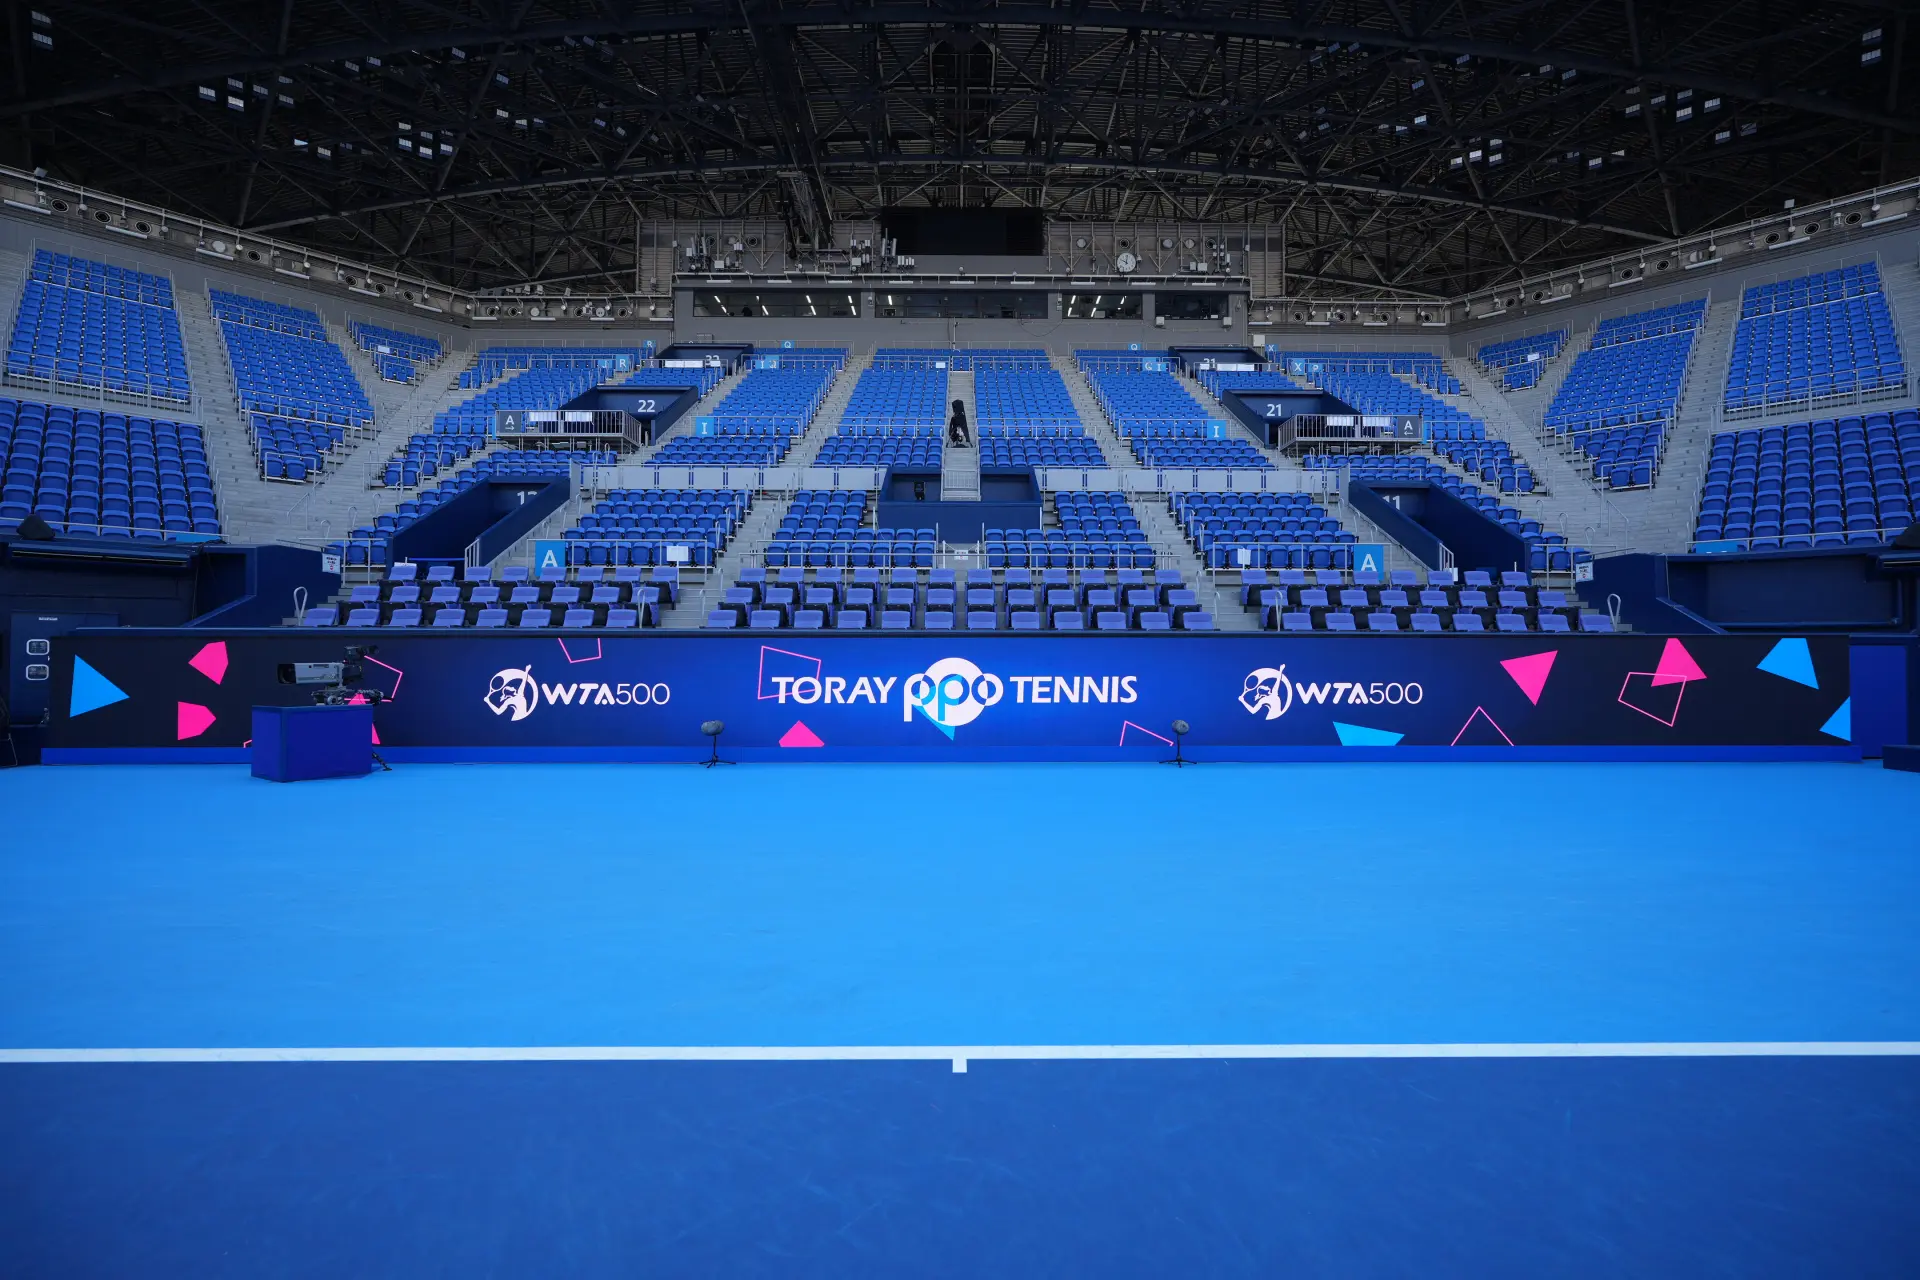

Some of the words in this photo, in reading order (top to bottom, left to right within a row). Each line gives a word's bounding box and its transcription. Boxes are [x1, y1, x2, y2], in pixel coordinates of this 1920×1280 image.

[784, 341, 792, 349] Q
[1130, 343, 1138, 351] Q
[1268, 344, 1275, 352] X
[619, 358, 627, 368] R
[1294, 362, 1302, 372] X
[637, 400, 656, 413] 22
[1266, 403, 1282, 417] 21
[505, 415, 515, 425] A
[1404, 420, 1413, 431] A
[701, 422, 708, 435] I
[1213, 425, 1220, 438] I
[516, 490, 537, 505] 1
[541, 549, 558, 568] A
[1360, 553, 1377, 572] A
[541, 682, 671, 705] WTA500
[771, 676, 898, 704] TORAY
[1010, 675, 1138, 704] TENNIS
[1295, 682, 1423, 705] WTA500
